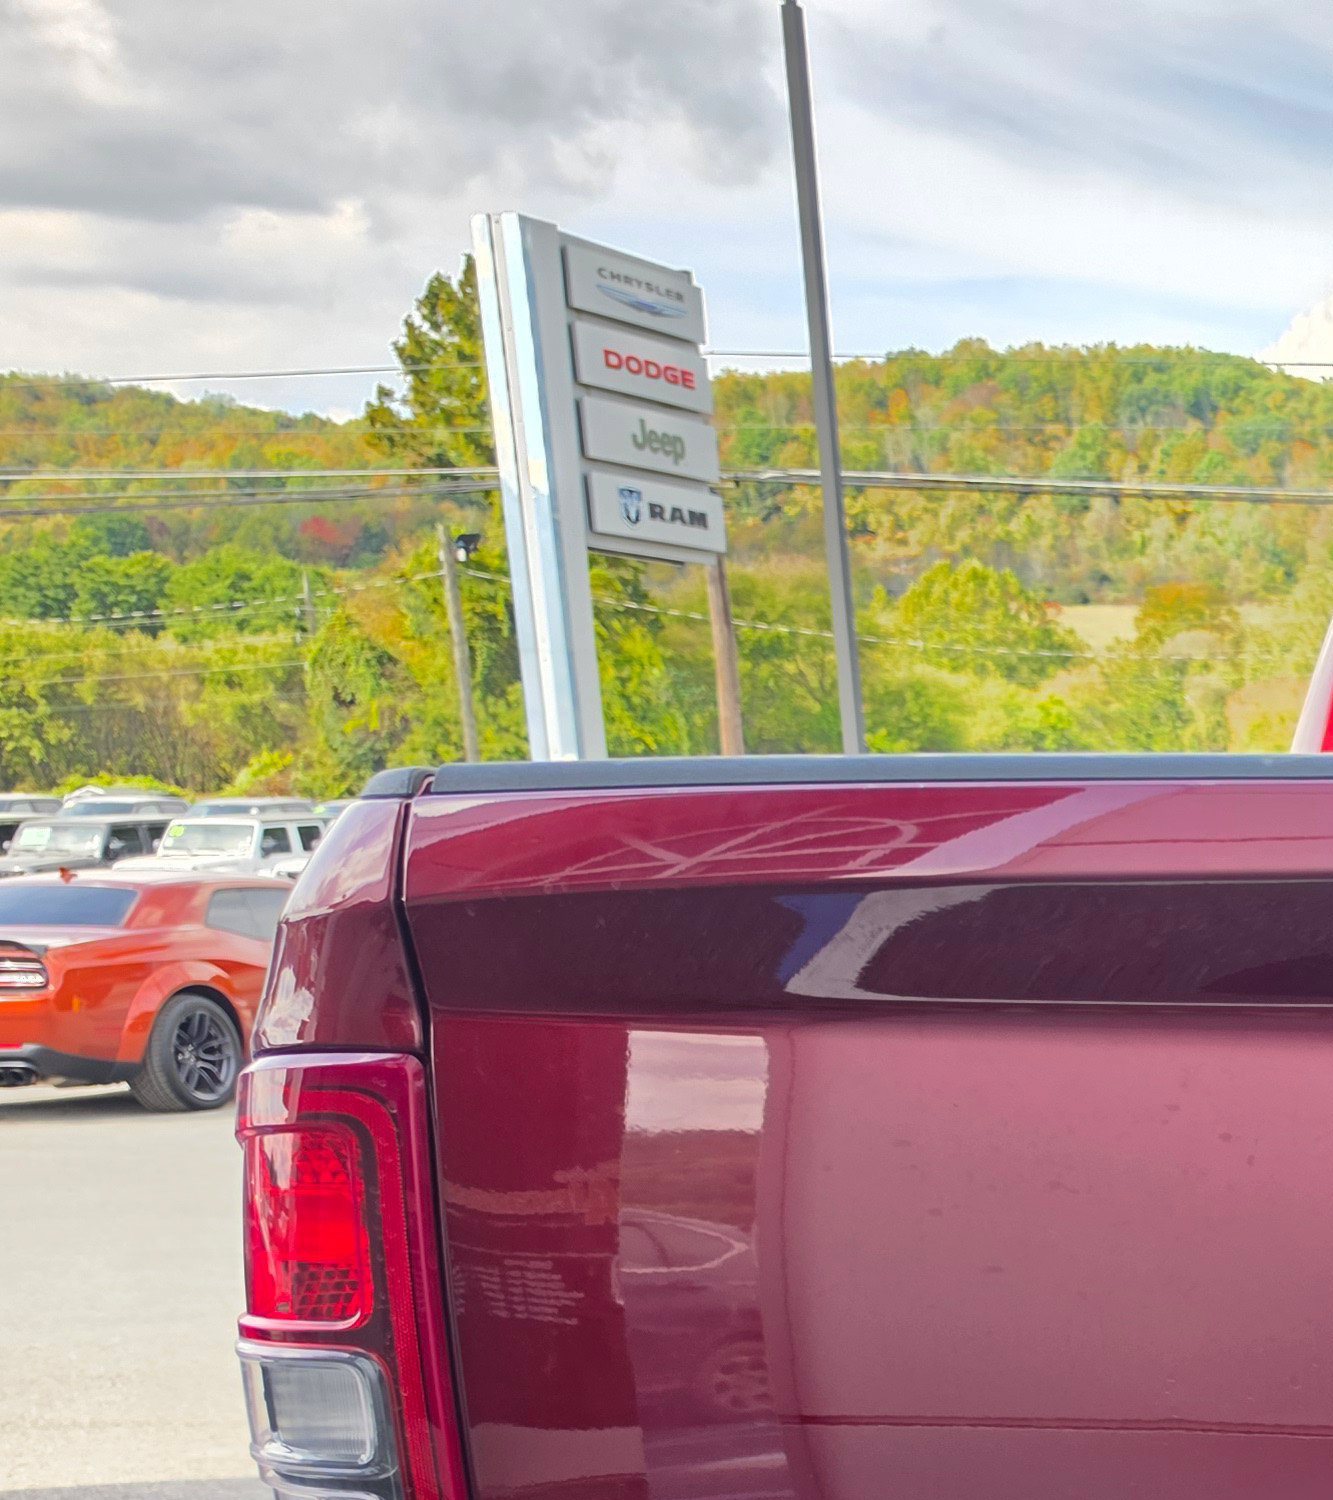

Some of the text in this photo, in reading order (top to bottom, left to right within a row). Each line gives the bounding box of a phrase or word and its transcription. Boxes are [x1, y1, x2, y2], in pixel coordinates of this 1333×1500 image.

[597, 266, 685, 302] CHRYSLER
[603, 348, 696, 390] DODGE
[632, 417, 686, 465] Jeep
[648, 502, 709, 530] RAM
